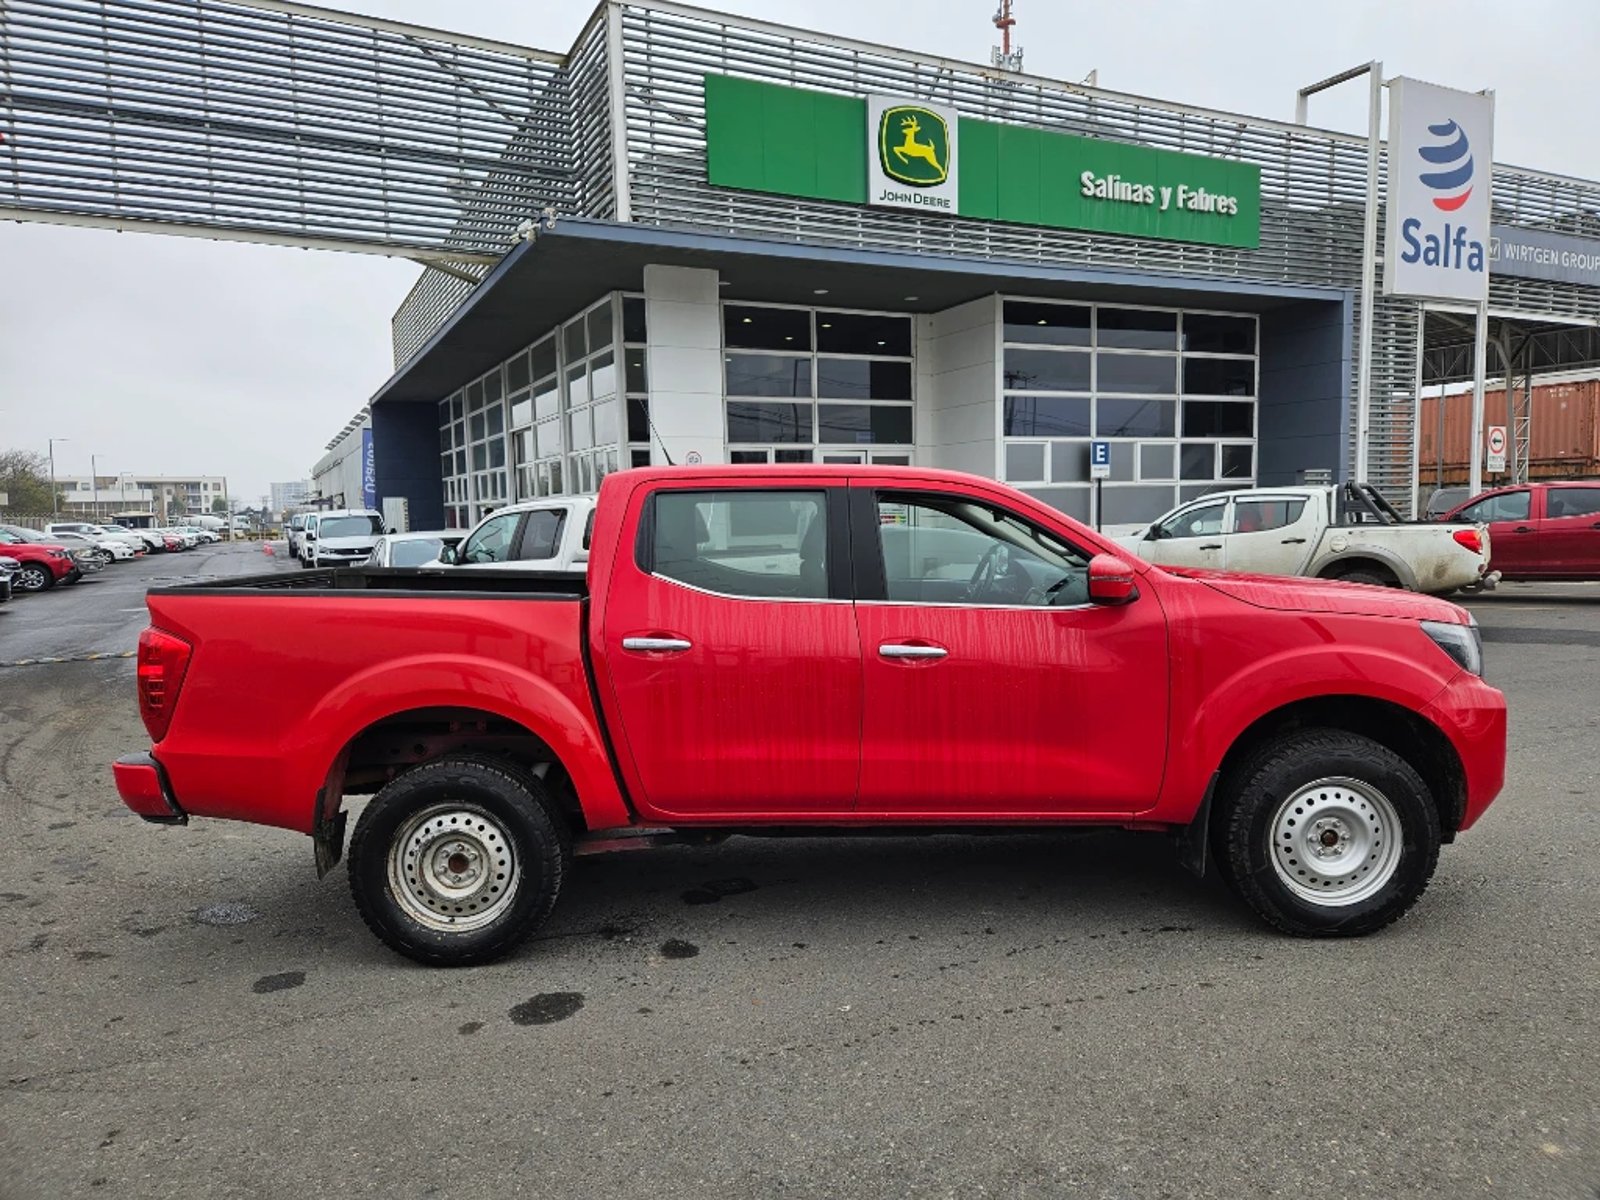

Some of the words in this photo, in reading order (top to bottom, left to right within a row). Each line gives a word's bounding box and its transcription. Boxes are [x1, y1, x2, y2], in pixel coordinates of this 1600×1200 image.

[879, 189, 912, 204] JOHN
[913, 192, 951, 209] DEERE
[1080, 170, 1155, 204] Salinas
[1159, 186, 1172, 211] y
[1176, 183, 1238, 215] Fabres
[1401, 217, 1483, 272] Salfa
[1504, 243, 1559, 265] WIRTGEN
[1096, 444, 1106, 462] E
